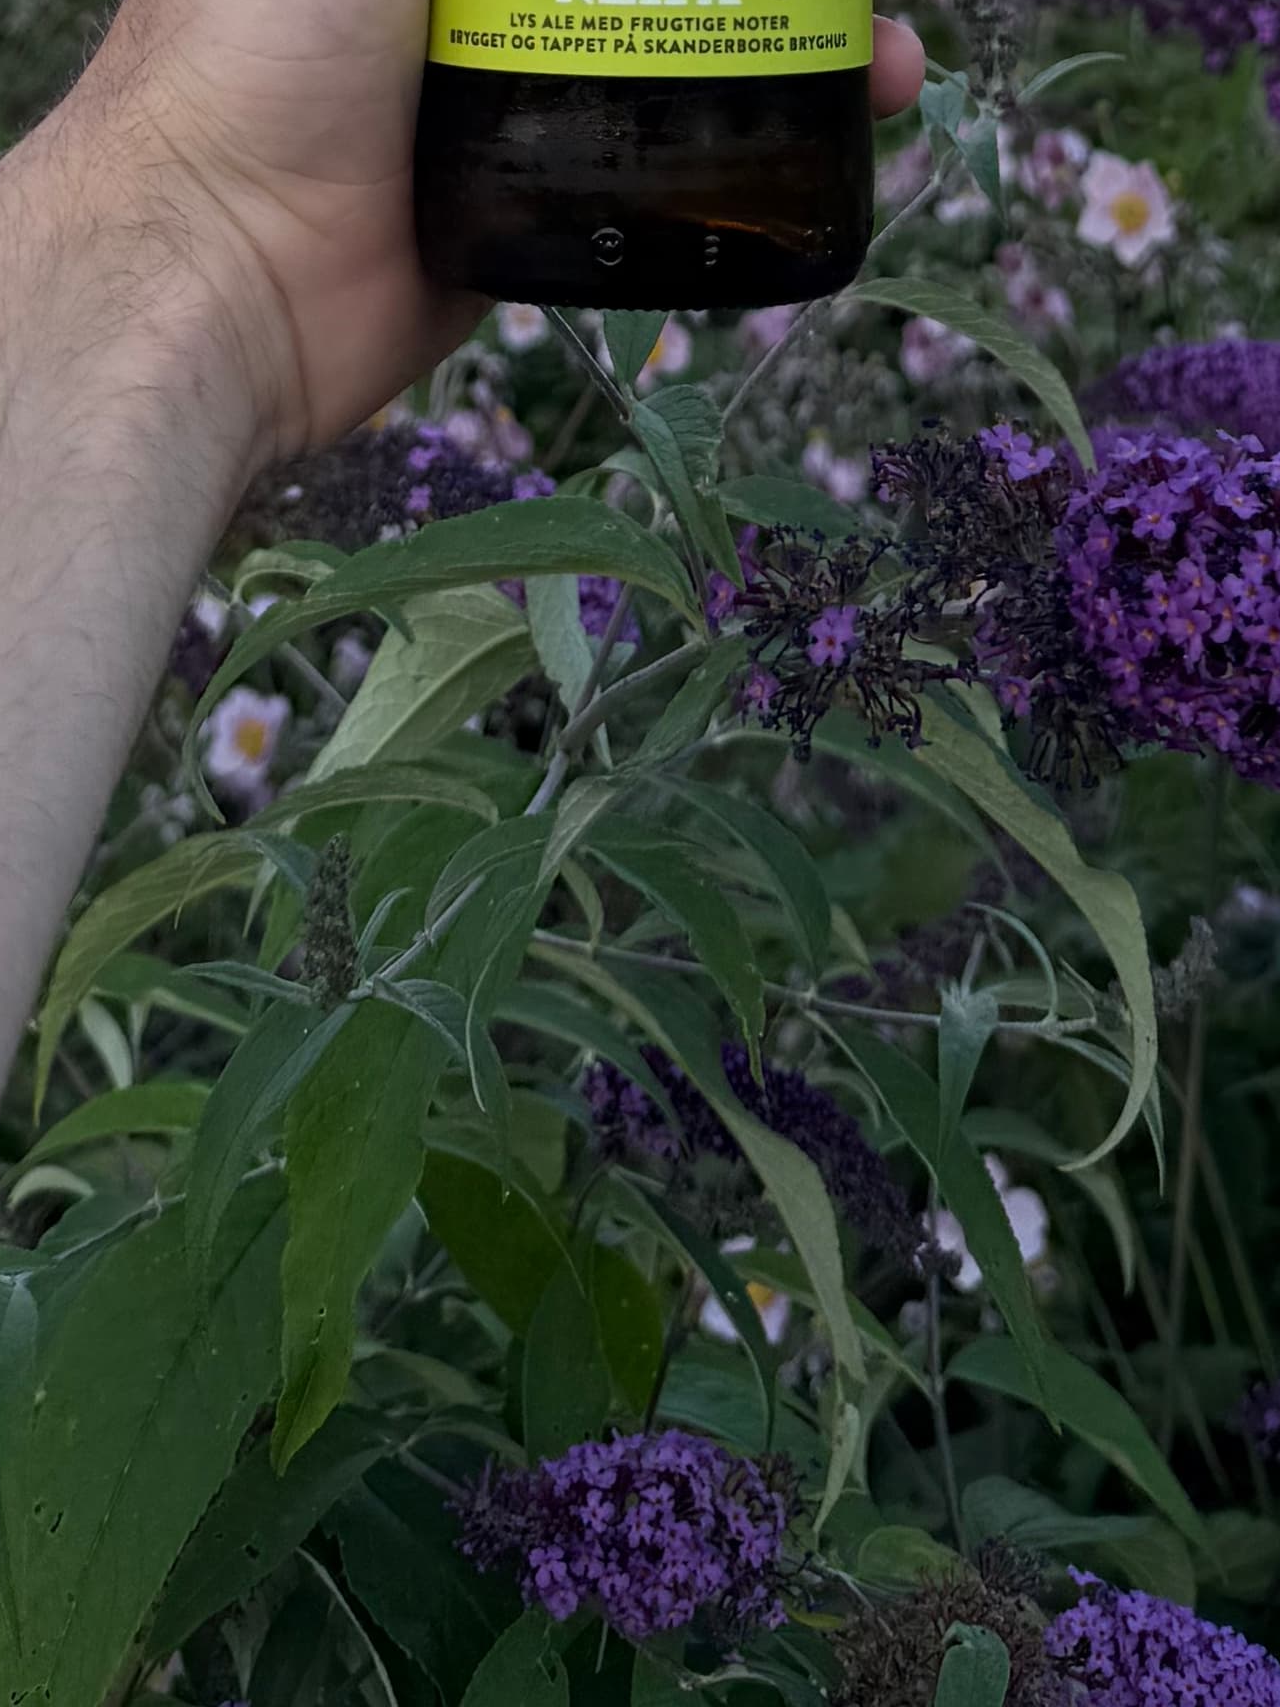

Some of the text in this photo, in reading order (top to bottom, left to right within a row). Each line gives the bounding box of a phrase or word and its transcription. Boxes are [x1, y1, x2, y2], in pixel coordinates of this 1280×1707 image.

[510, 12, 790, 32] LYS ALE MED FRUGTIGE NOTER
[450, 29, 848, 54] BRYGGET OG TAPPET PÅ SKANDERBORG BRYGHUS
